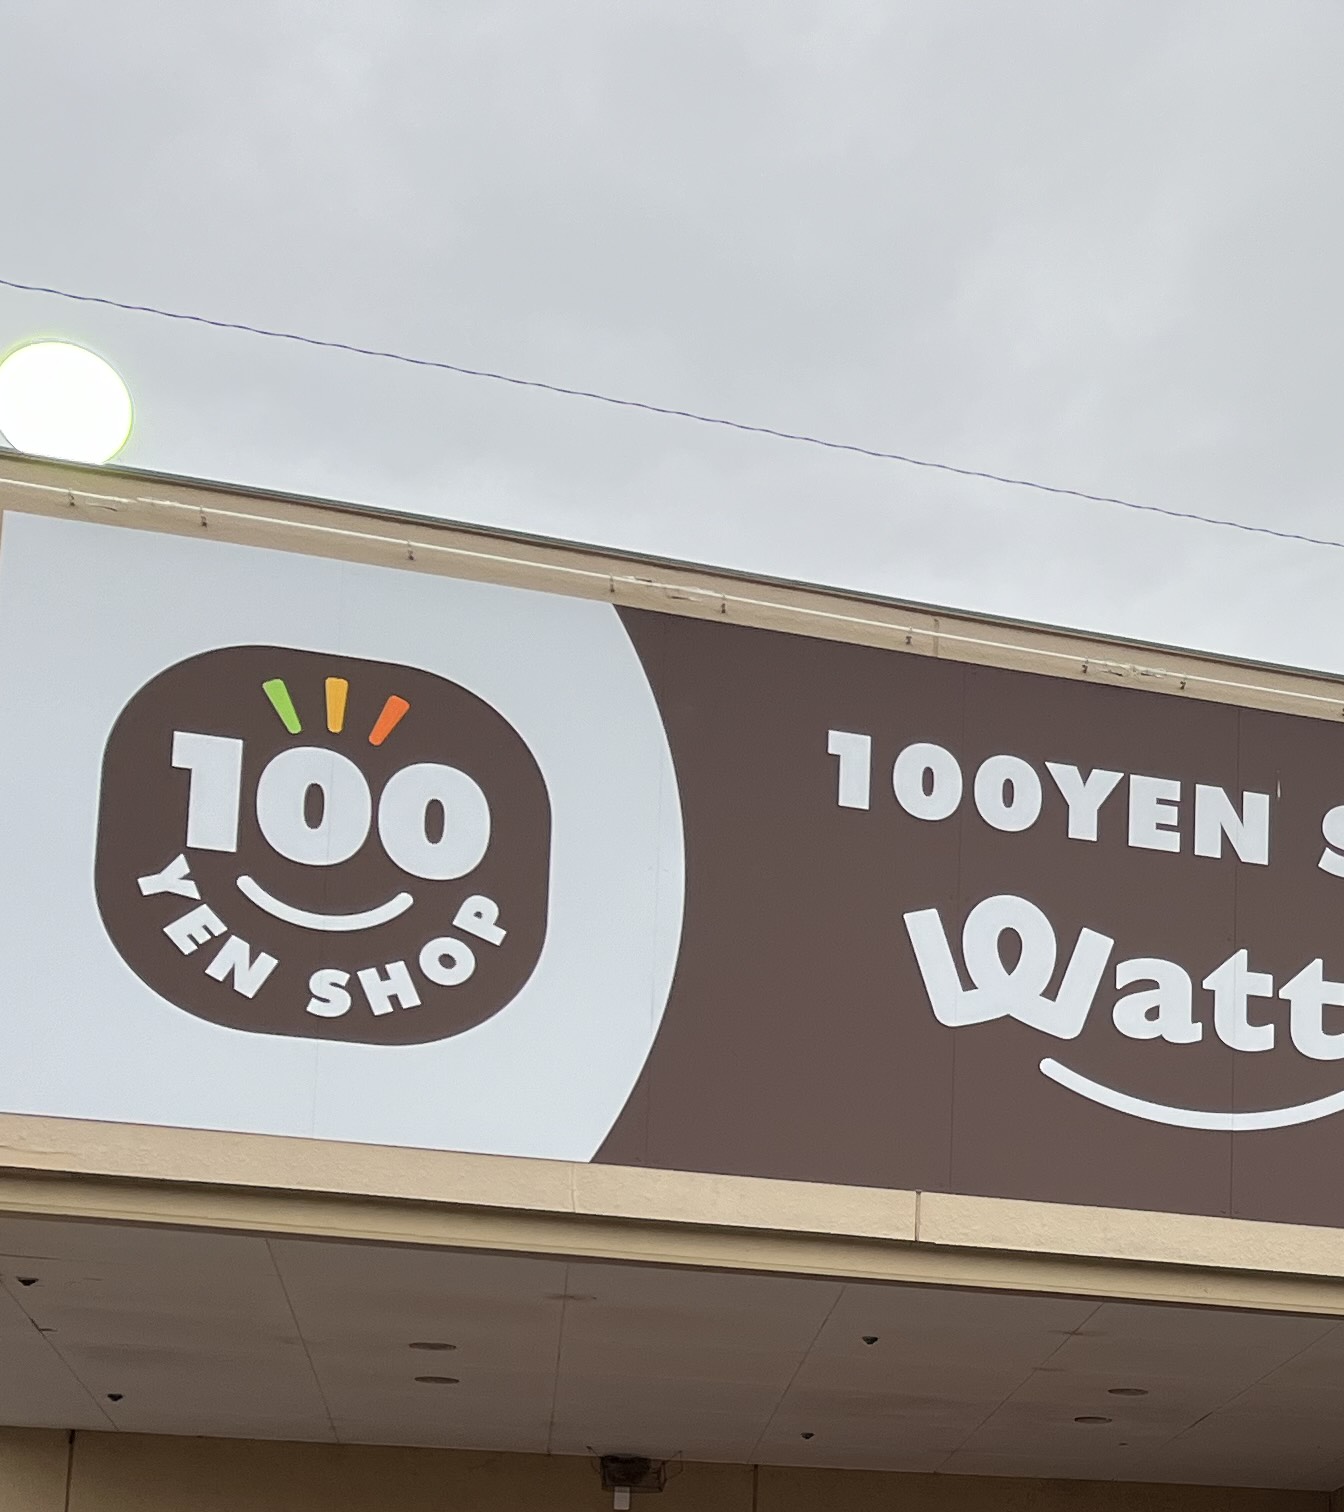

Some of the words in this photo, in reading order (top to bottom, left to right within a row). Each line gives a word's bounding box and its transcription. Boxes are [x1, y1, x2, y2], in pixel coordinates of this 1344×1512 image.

[171, 731, 491, 881] 100
[137, 853, 279, 999] YEN
[306, 893, 507, 1018] SHOP
